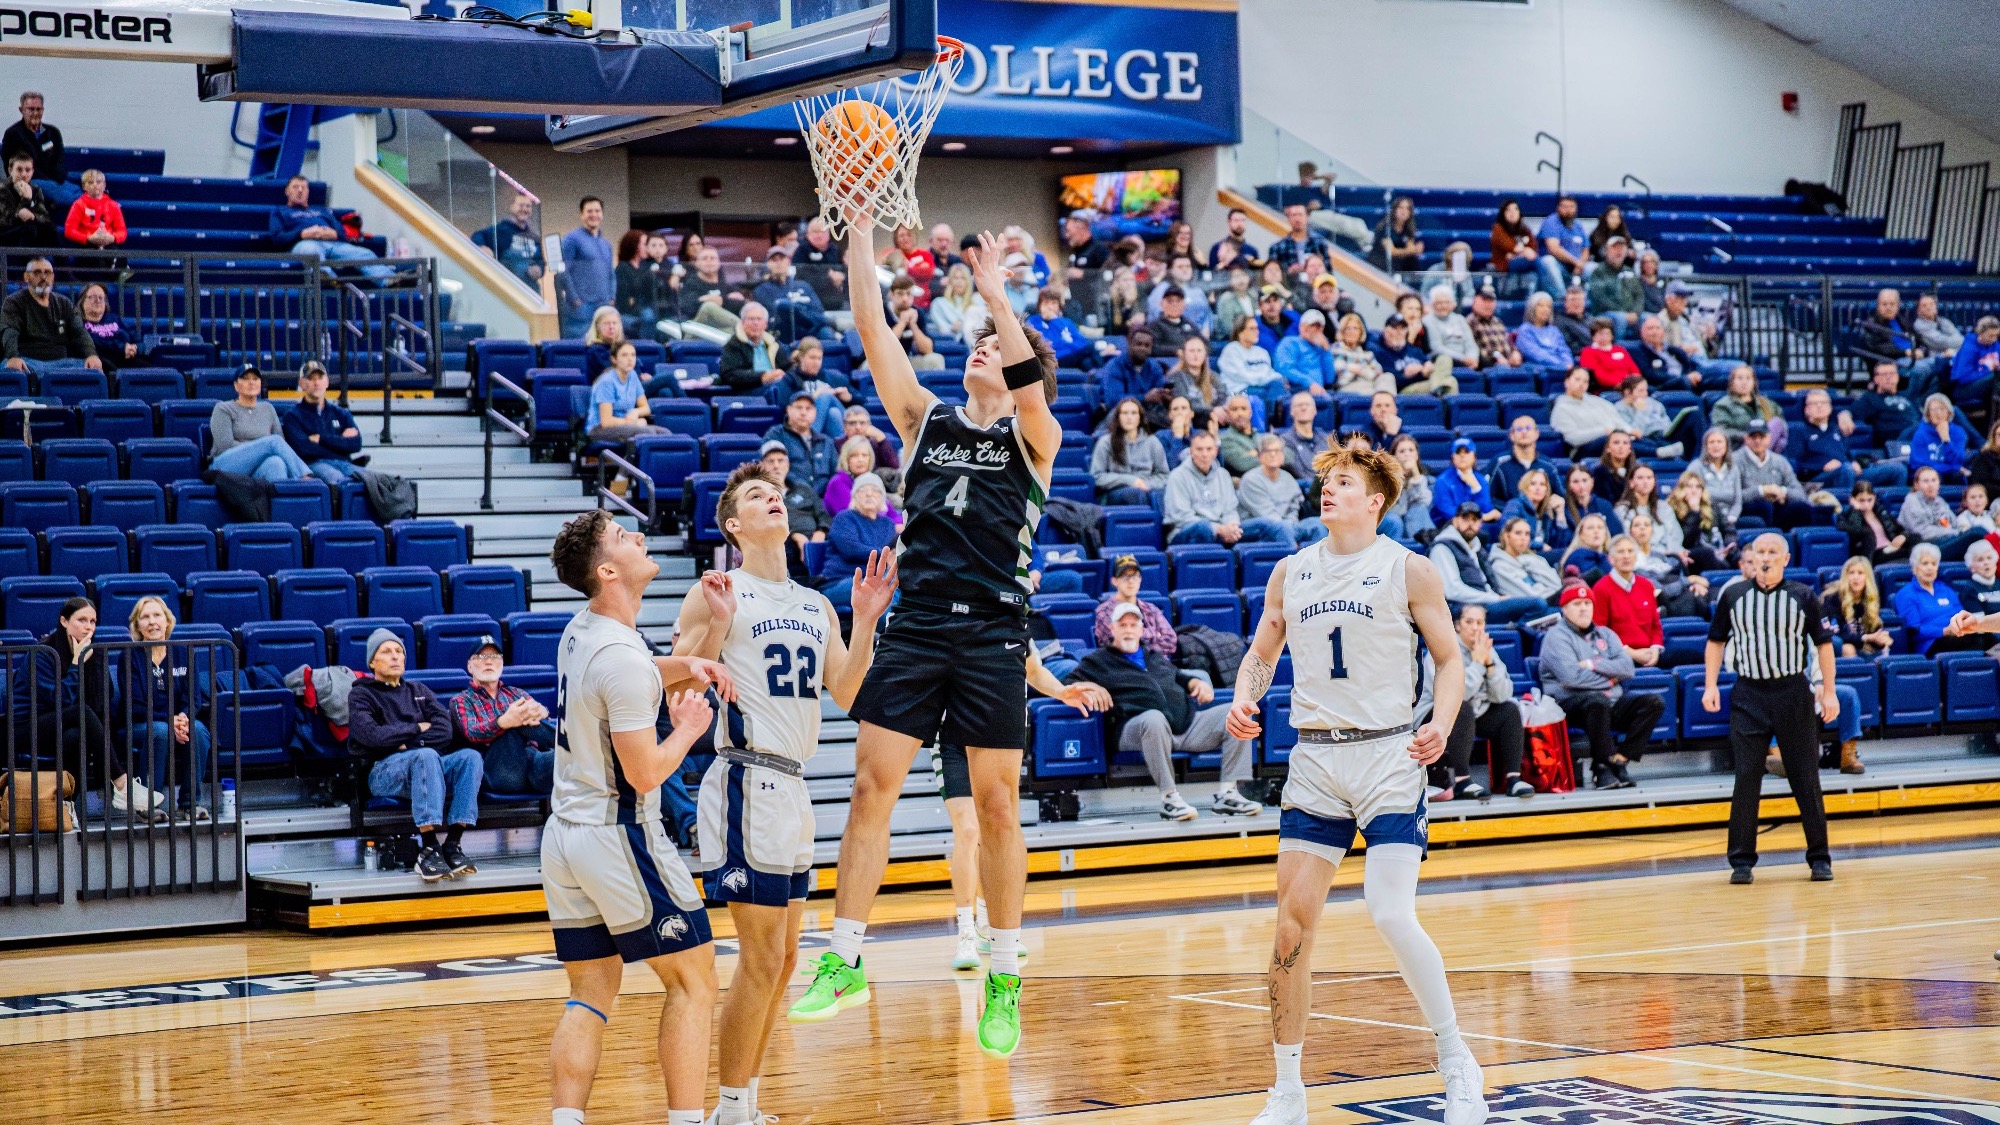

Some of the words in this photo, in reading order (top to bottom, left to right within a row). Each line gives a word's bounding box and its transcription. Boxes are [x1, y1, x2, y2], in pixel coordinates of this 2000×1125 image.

[923, 443, 971, 466] Lake
[976, 440, 1010, 462] Erie
[944, 475, 970, 517] 4
[1300, 599, 1374, 623] HILLSDALE
[751, 618, 823, 645] HILLSDALE
[1327, 625, 1349, 680] 1
[763, 642, 819, 699] 22
